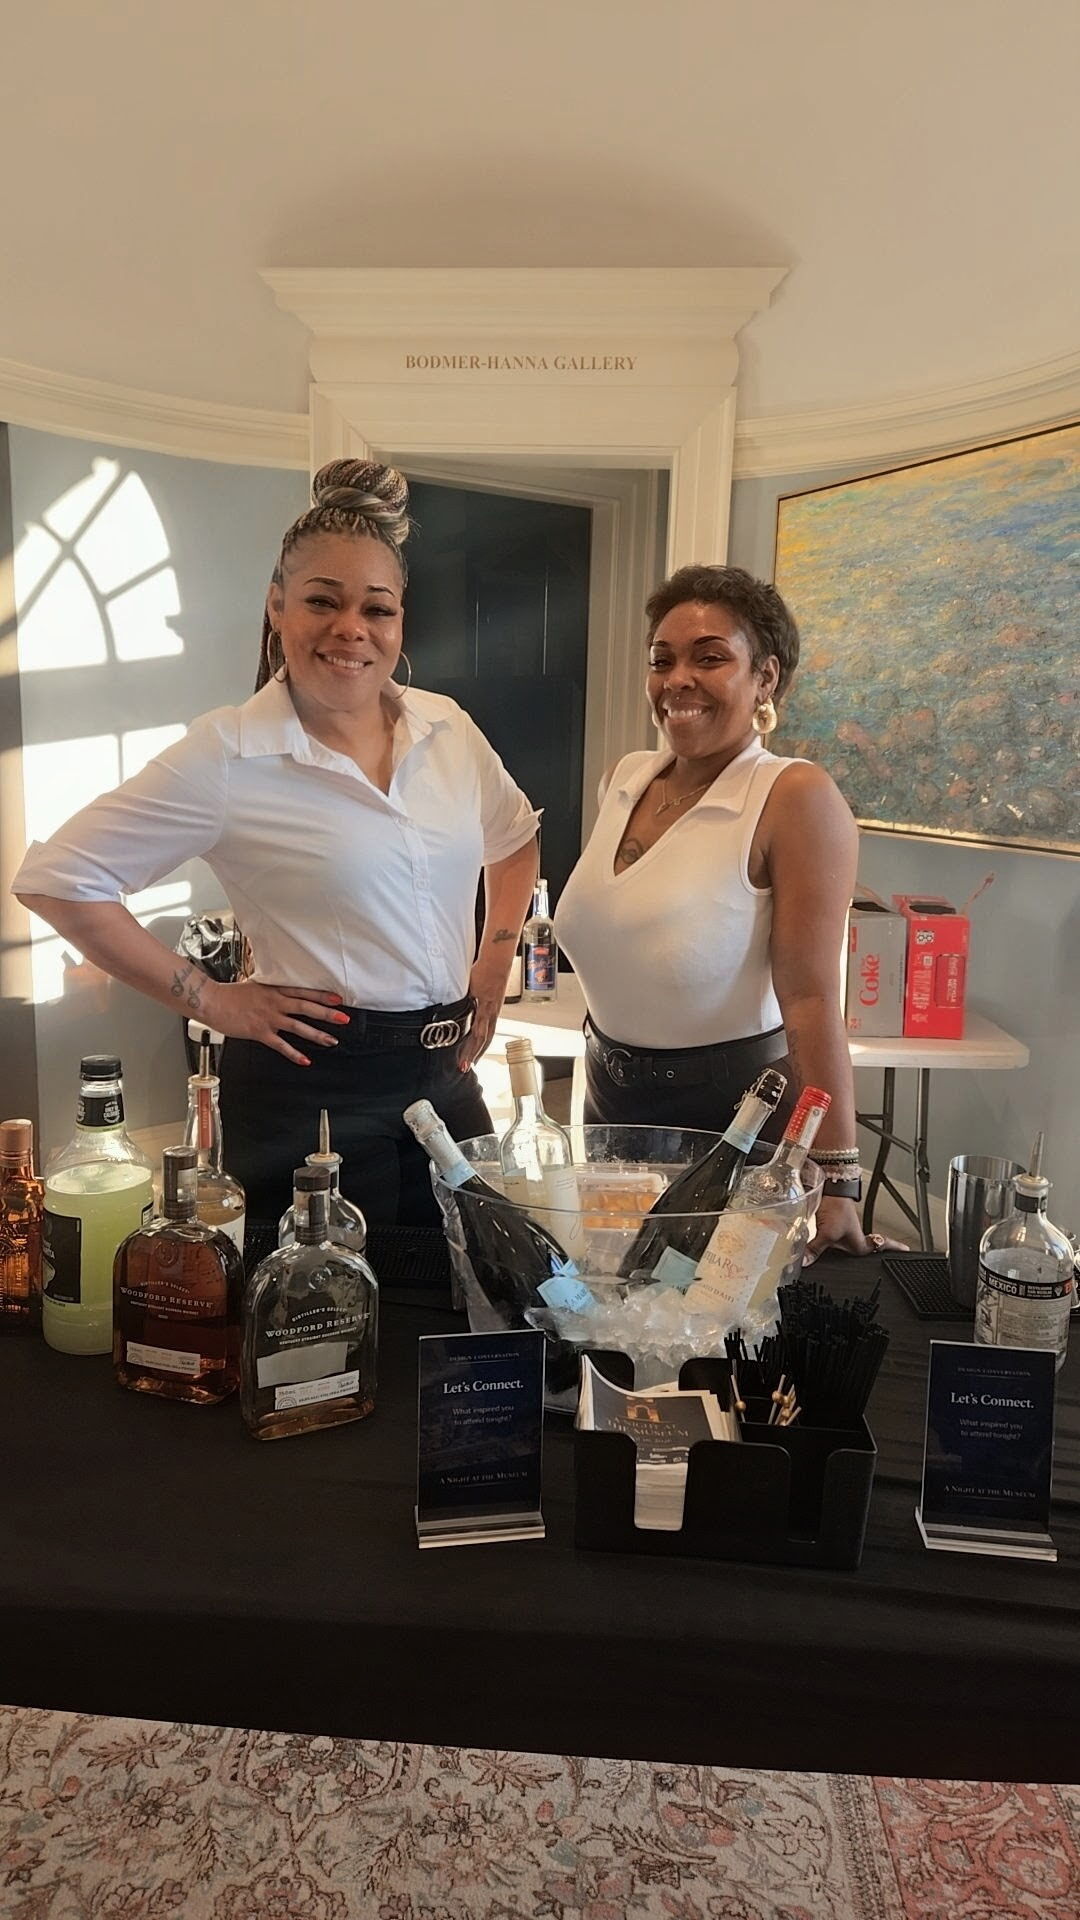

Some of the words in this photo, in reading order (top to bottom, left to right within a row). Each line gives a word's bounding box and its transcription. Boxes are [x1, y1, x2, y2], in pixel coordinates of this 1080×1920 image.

[406, 355, 548, 370] BODMER-HANNA
[553, 356, 638, 370] GALLERY
[859, 954, 880, 1007] Coke
[988, 1277, 1017, 1294] MEXICO
[120, 1287, 167, 1302] WOODFORD
[169, 1296, 212, 1309] RESERVE
[265, 1322, 323, 1338] WOODFORD
[326, 1312, 369, 1328] RESERVE
[443, 1381, 471, 1394] Let's
[472, 1379, 524, 1392] Connect.
[951, 1391, 979, 1404] Let's
[980, 1394, 1035, 1409] Connect.
[473, 1406, 500, 1414] inspired
[501, 1405, 514, 1413] you
[486, 1415, 512, 1424] tonight?
[959, 1418, 978, 1427] What
[980, 1420, 1008, 1429] inspired
[1009, 1422, 1023, 1431] you
[993, 1432, 1021, 1441] tonight?
[495, 1471, 528, 1479] MUSEUM
[951, 1485, 975, 1494] NIGHT
[1001, 1488, 1036, 1498] MUSEUM
